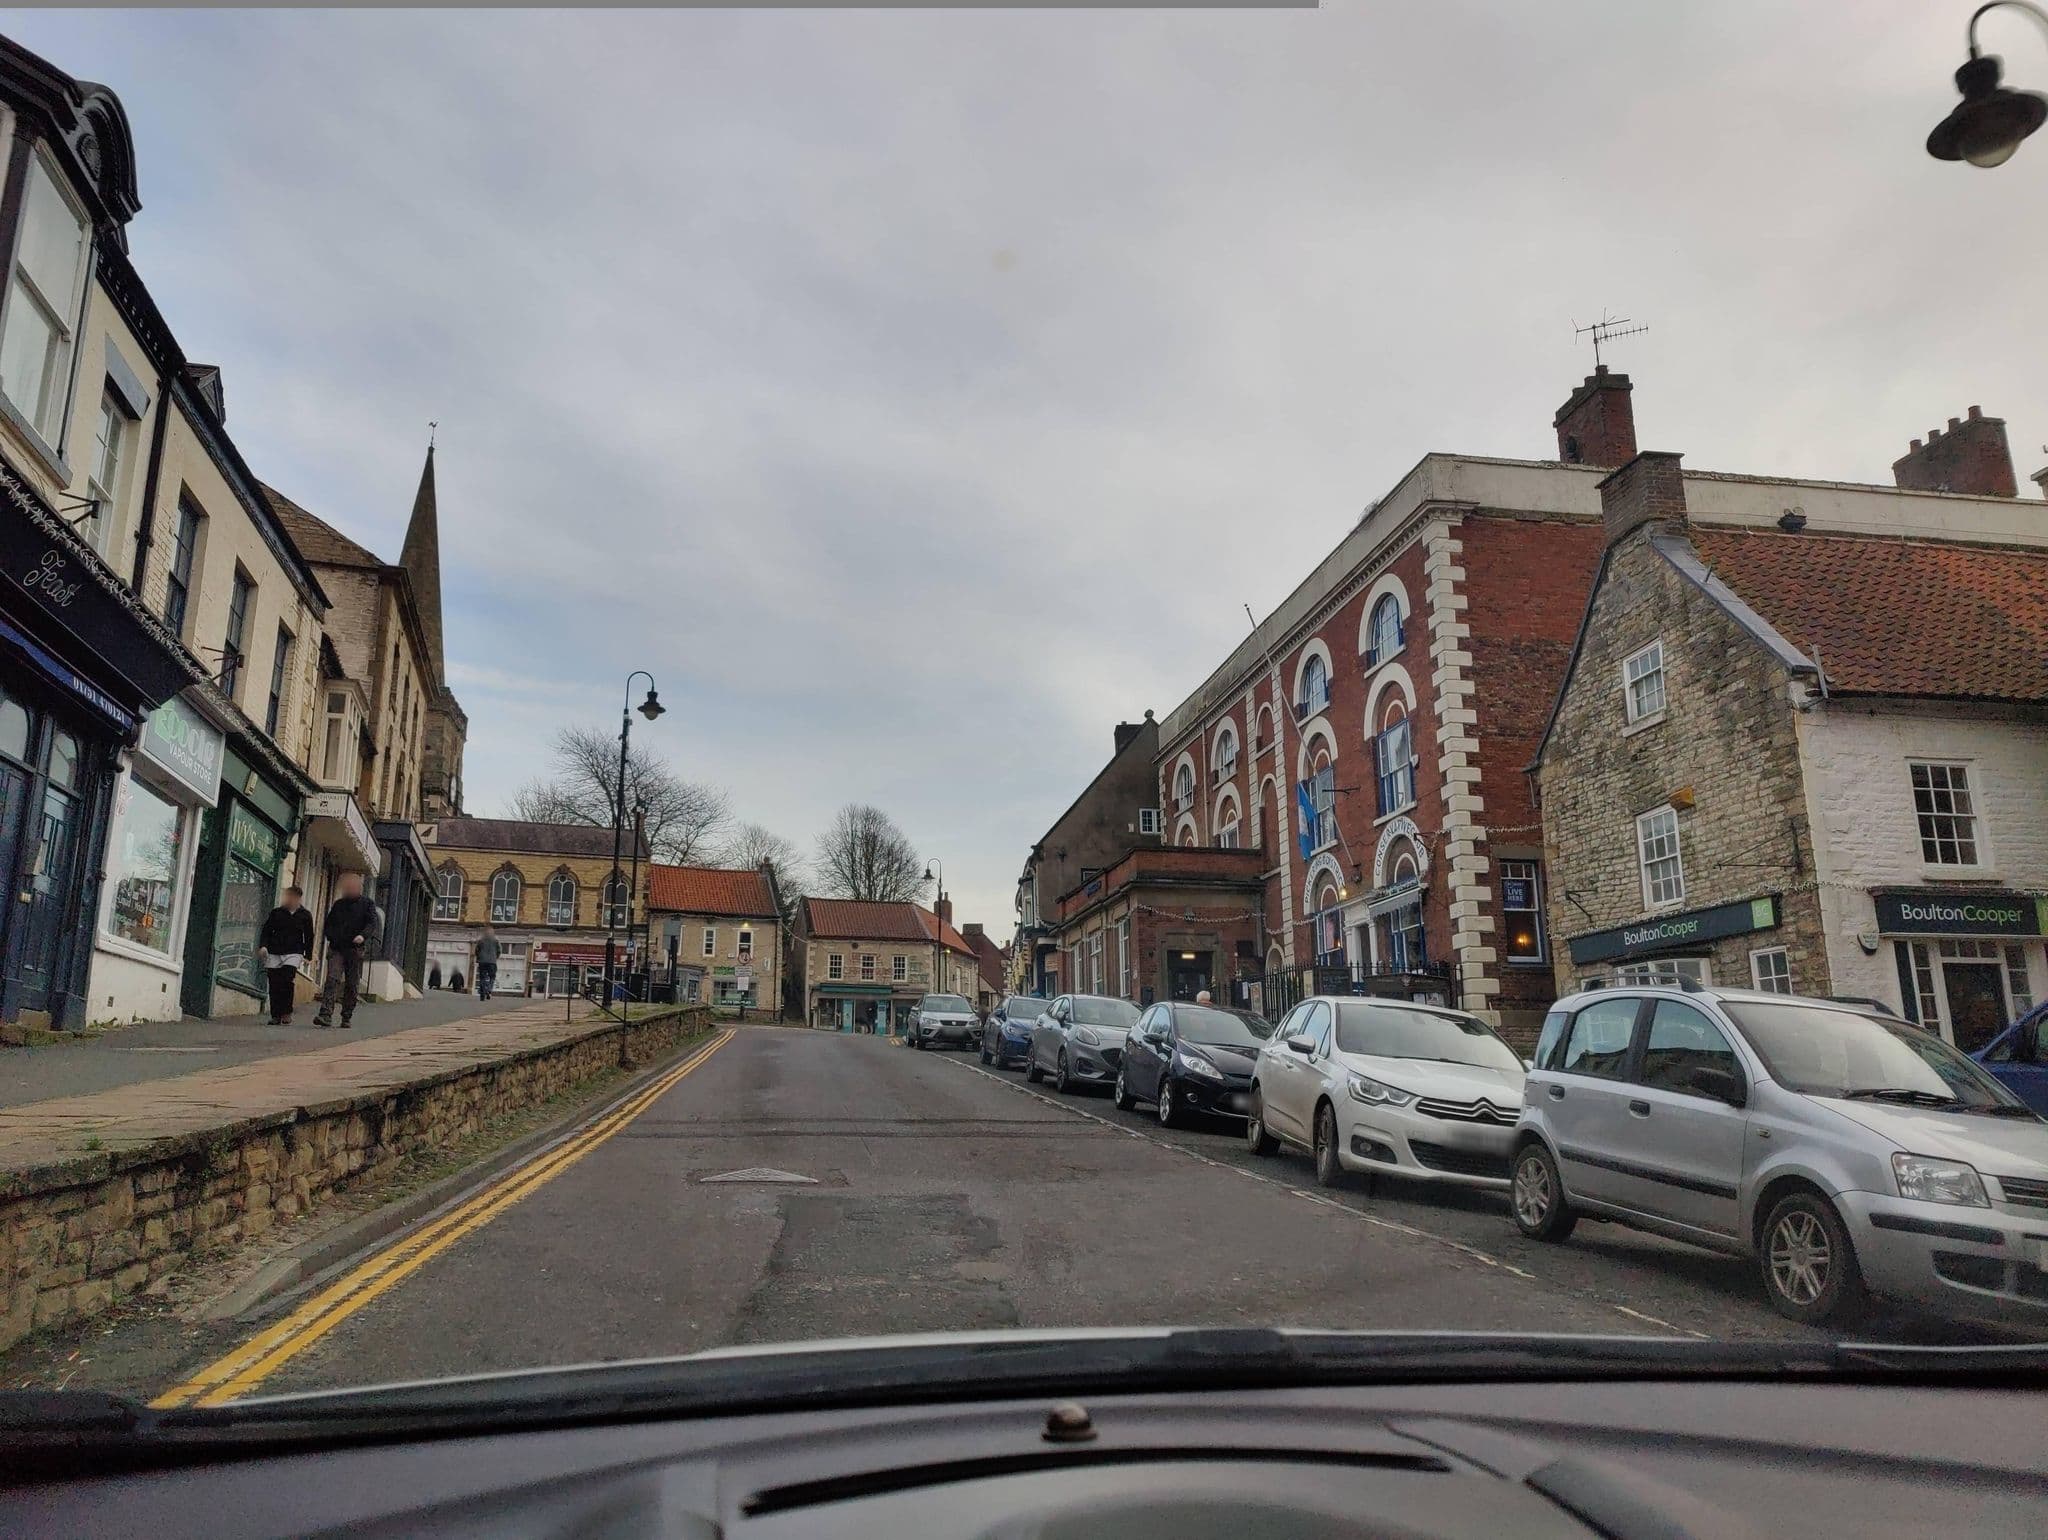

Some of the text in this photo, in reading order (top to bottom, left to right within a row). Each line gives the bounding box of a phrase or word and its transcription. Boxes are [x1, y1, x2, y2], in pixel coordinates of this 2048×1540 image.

[169, 743, 212, 785] VAPOUR STORE
[1507, 888, 1524, 896] LIVE
[1901, 903, 2023, 926] BoultonCooper
[1623, 919, 1699, 946] BoultonCooper
